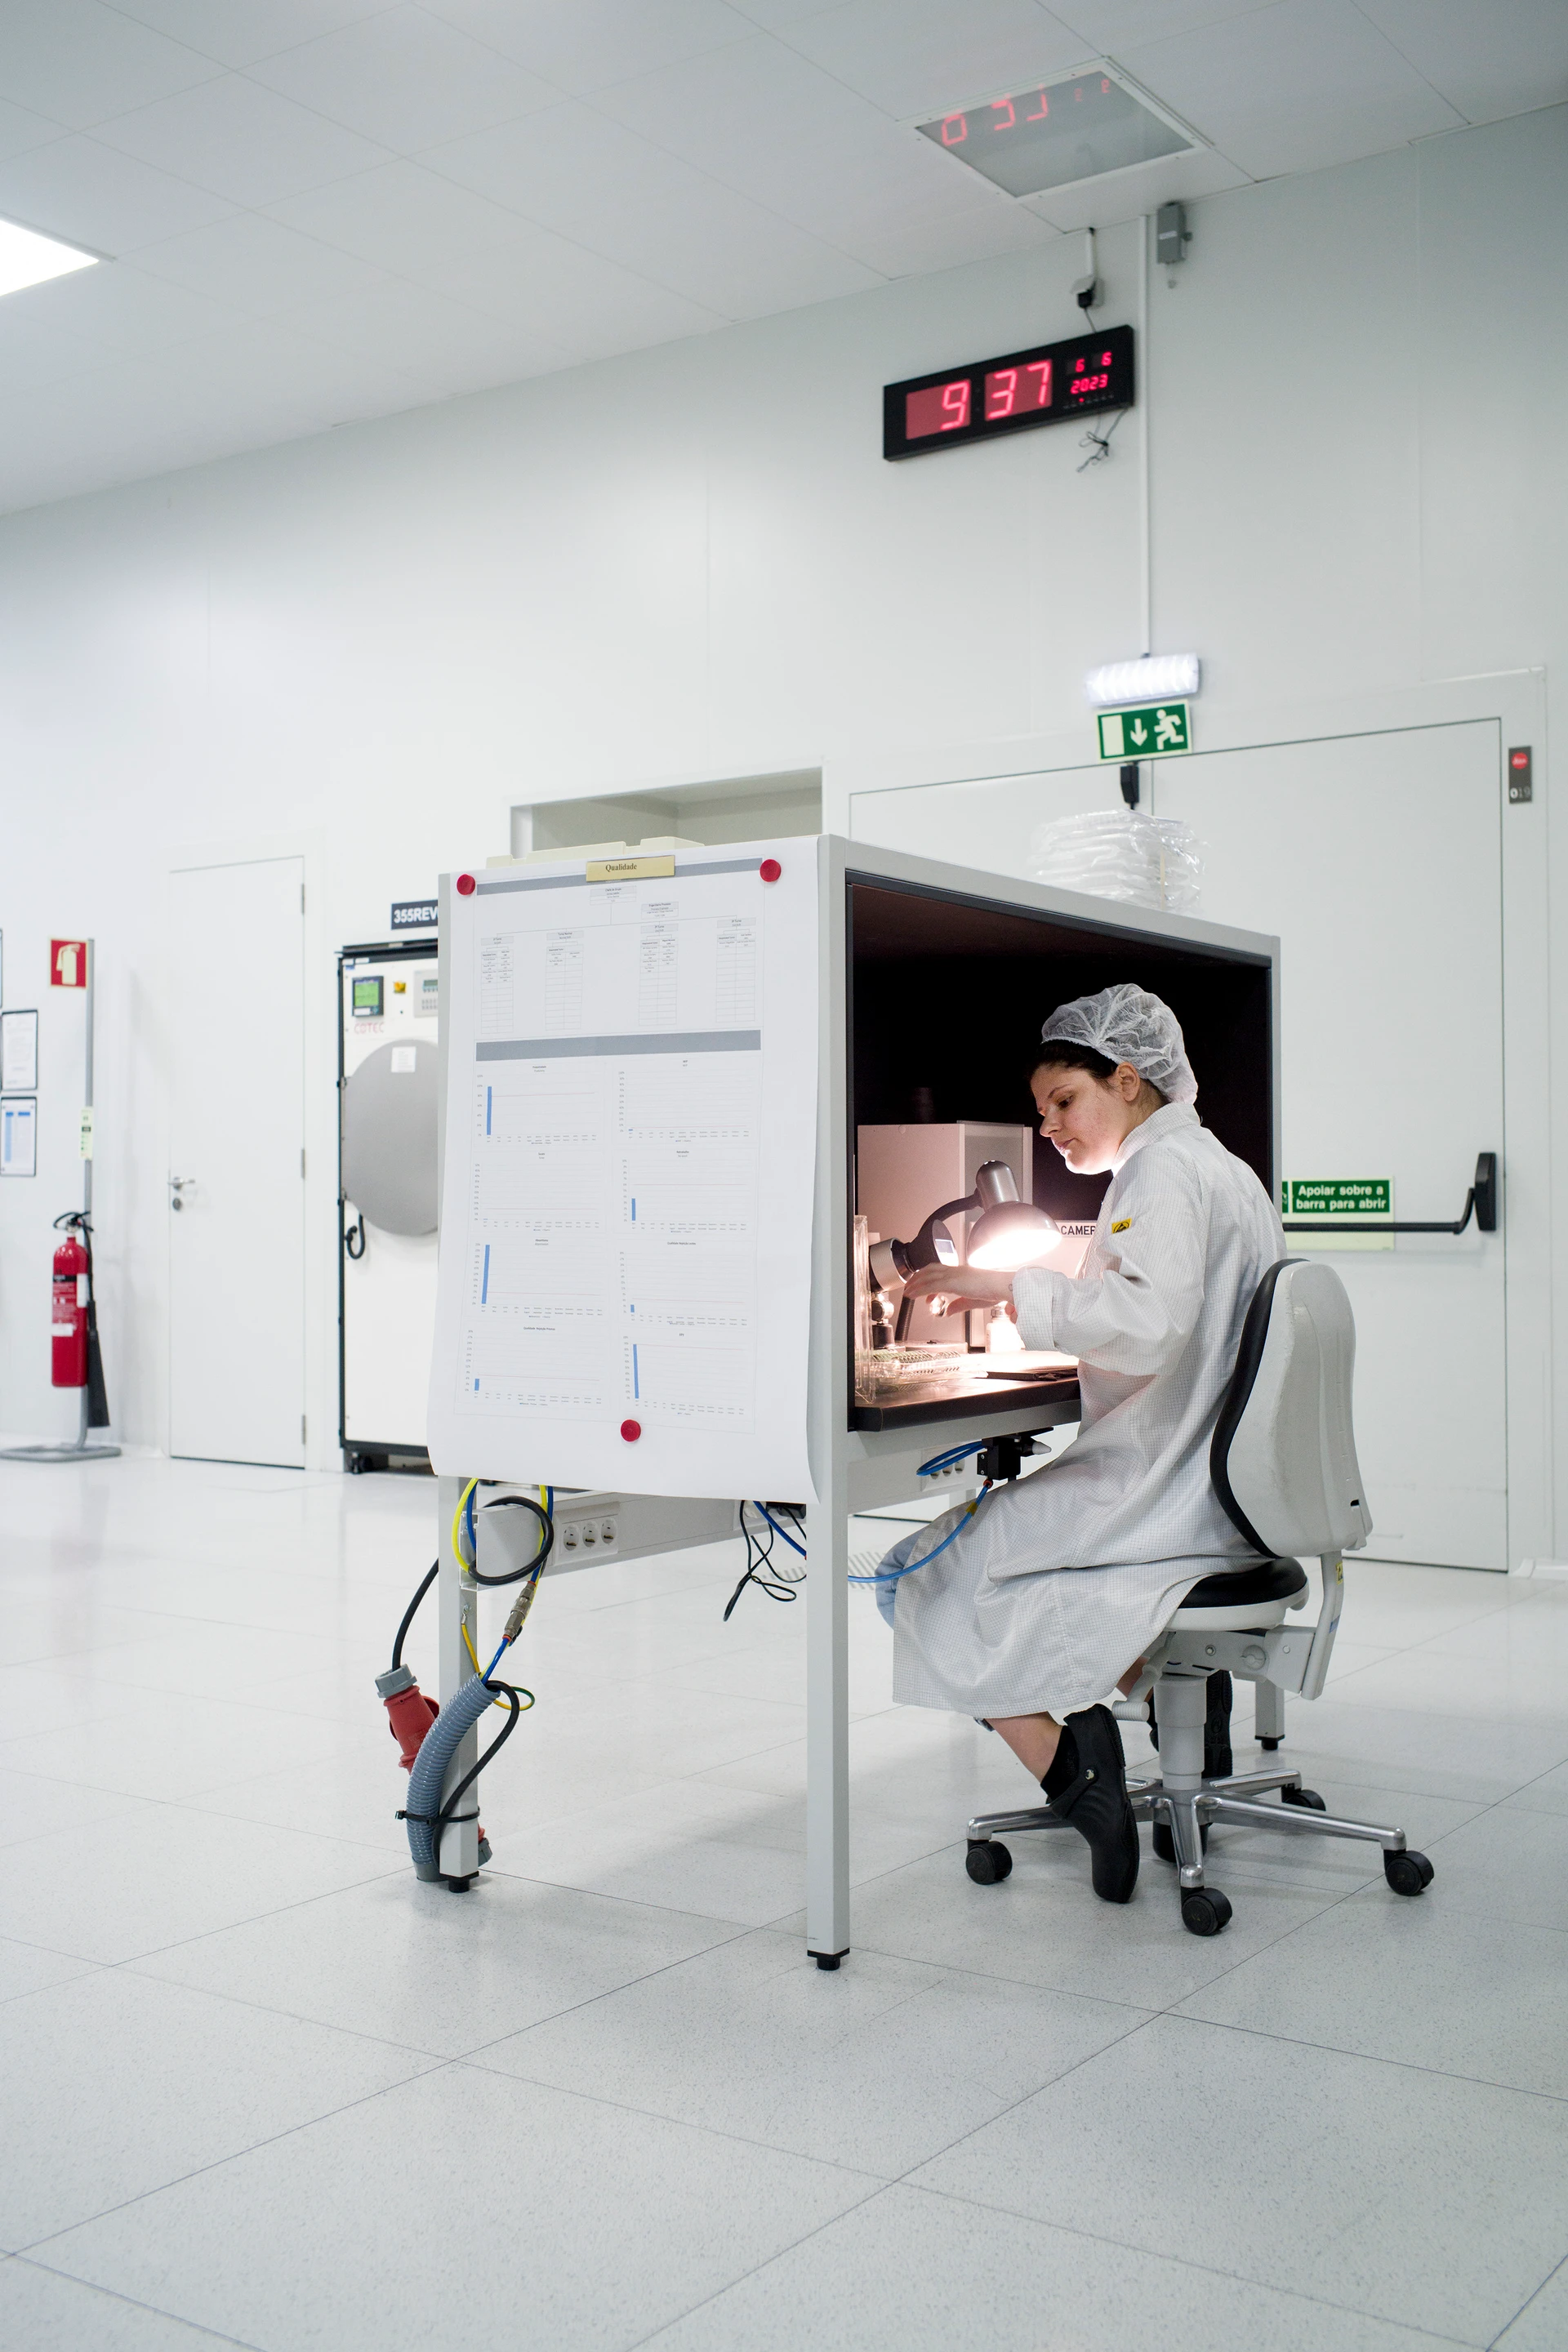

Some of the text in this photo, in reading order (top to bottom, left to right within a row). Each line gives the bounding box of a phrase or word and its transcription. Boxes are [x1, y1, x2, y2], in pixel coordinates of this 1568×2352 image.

[1075, 350, 1112, 373] 6 6
[1070, 373, 1108, 394] 2023
[940, 360, 1052, 430] 9 37
[605, 862, 638, 872] Qualidade
[1298, 1184, 1383, 1198] Apoiar sobre a
[1296, 1197, 1387, 1211] barra para abrir
